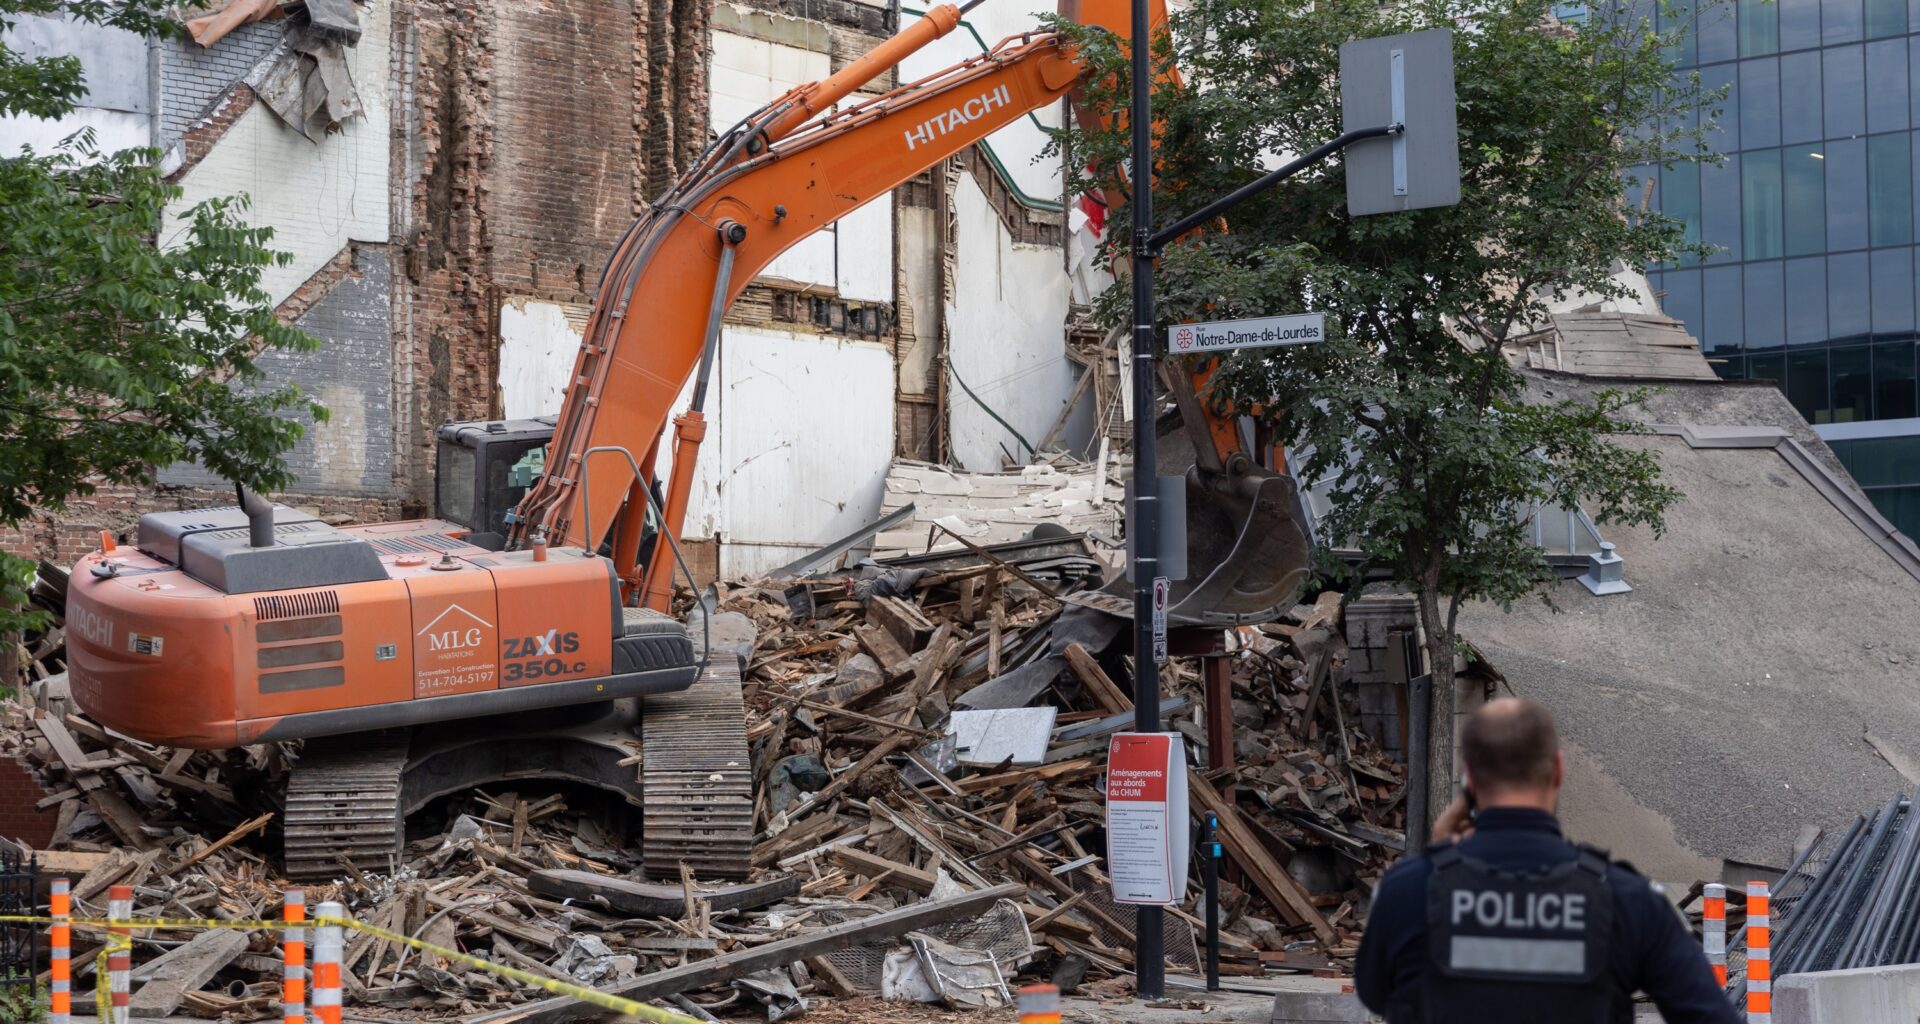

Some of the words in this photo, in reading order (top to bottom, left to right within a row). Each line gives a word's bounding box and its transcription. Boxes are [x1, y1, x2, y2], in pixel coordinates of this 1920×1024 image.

[904, 84, 1011, 151] HITACHI
[1196, 323, 1319, 347] Notre-Dame-de-Lourdes
[429, 628, 482, 651] MLG
[503, 629, 579, 659] ZAXIS
[438, 650, 475, 660] HABITATIONS
[418, 667, 451, 677] Excavation
[456, 663, 495, 673] Construction
[504, 658, 586, 681] 350LC
[419, 671, 494, 690] 514-704-5197
[1111, 768, 1162, 779] Aménagements
[1123, 778, 1146, 787] abords
[1110, 788, 1119, 796] du
[1120, 788, 1141, 796] CHUM
[1452, 889, 1586, 930] POLICE
